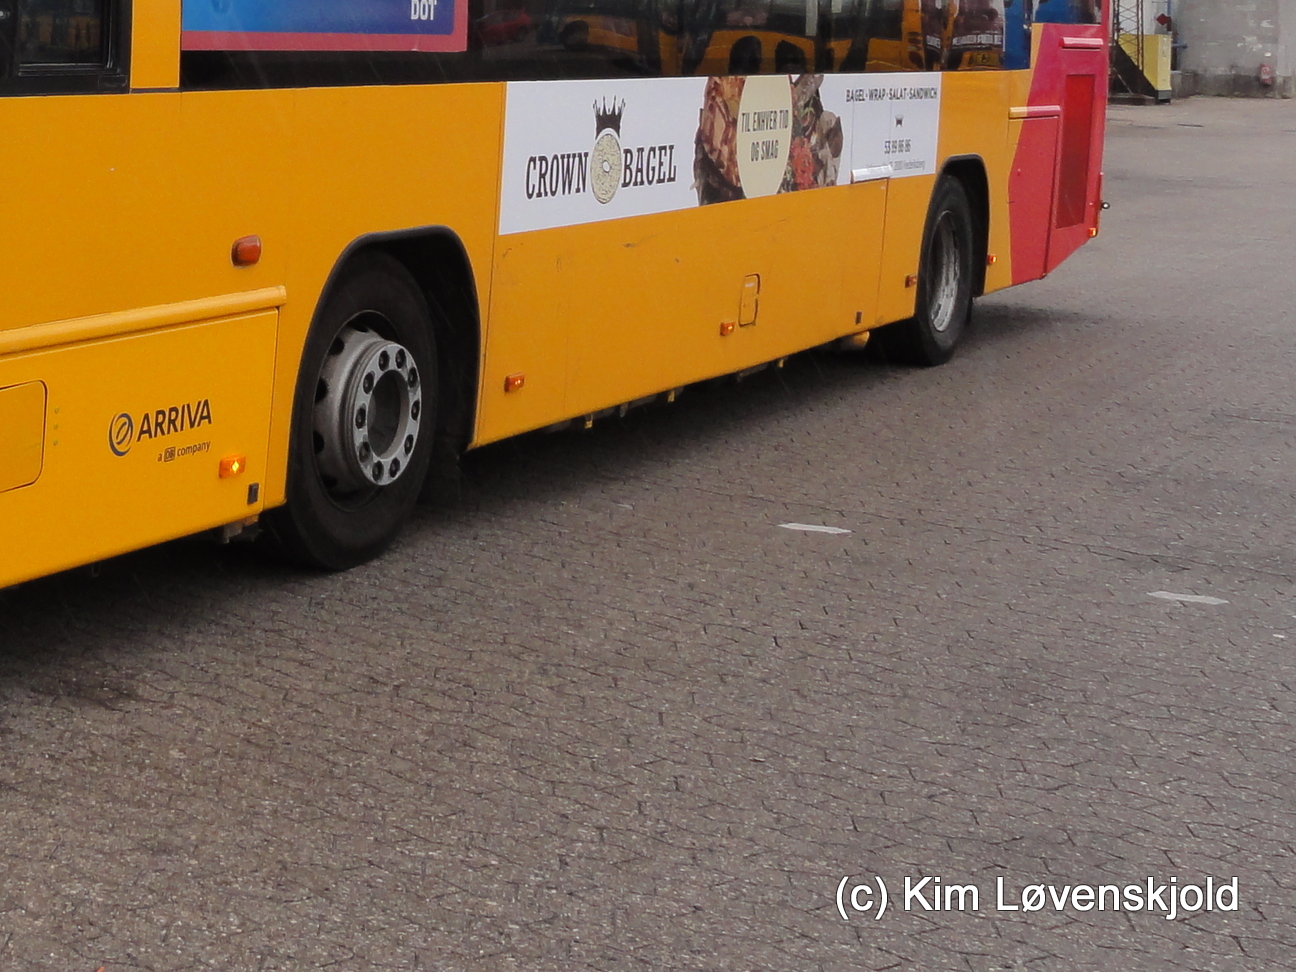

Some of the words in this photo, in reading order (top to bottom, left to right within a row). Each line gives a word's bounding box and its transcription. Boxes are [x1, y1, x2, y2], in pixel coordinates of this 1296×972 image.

[741, 112, 751, 132] TIL
[753, 110, 777, 131] ENHVER
[779, 109, 789, 129] TID
[750, 141, 760, 161] OG
[761, 139, 779, 160] SMAG
[525, 151, 588, 200] CROWN
[621, 144, 676, 188] BAGEL
[137, 399, 212, 442] ARRIVA
[157, 453, 163, 462] a
[177, 440, 211, 456] company
